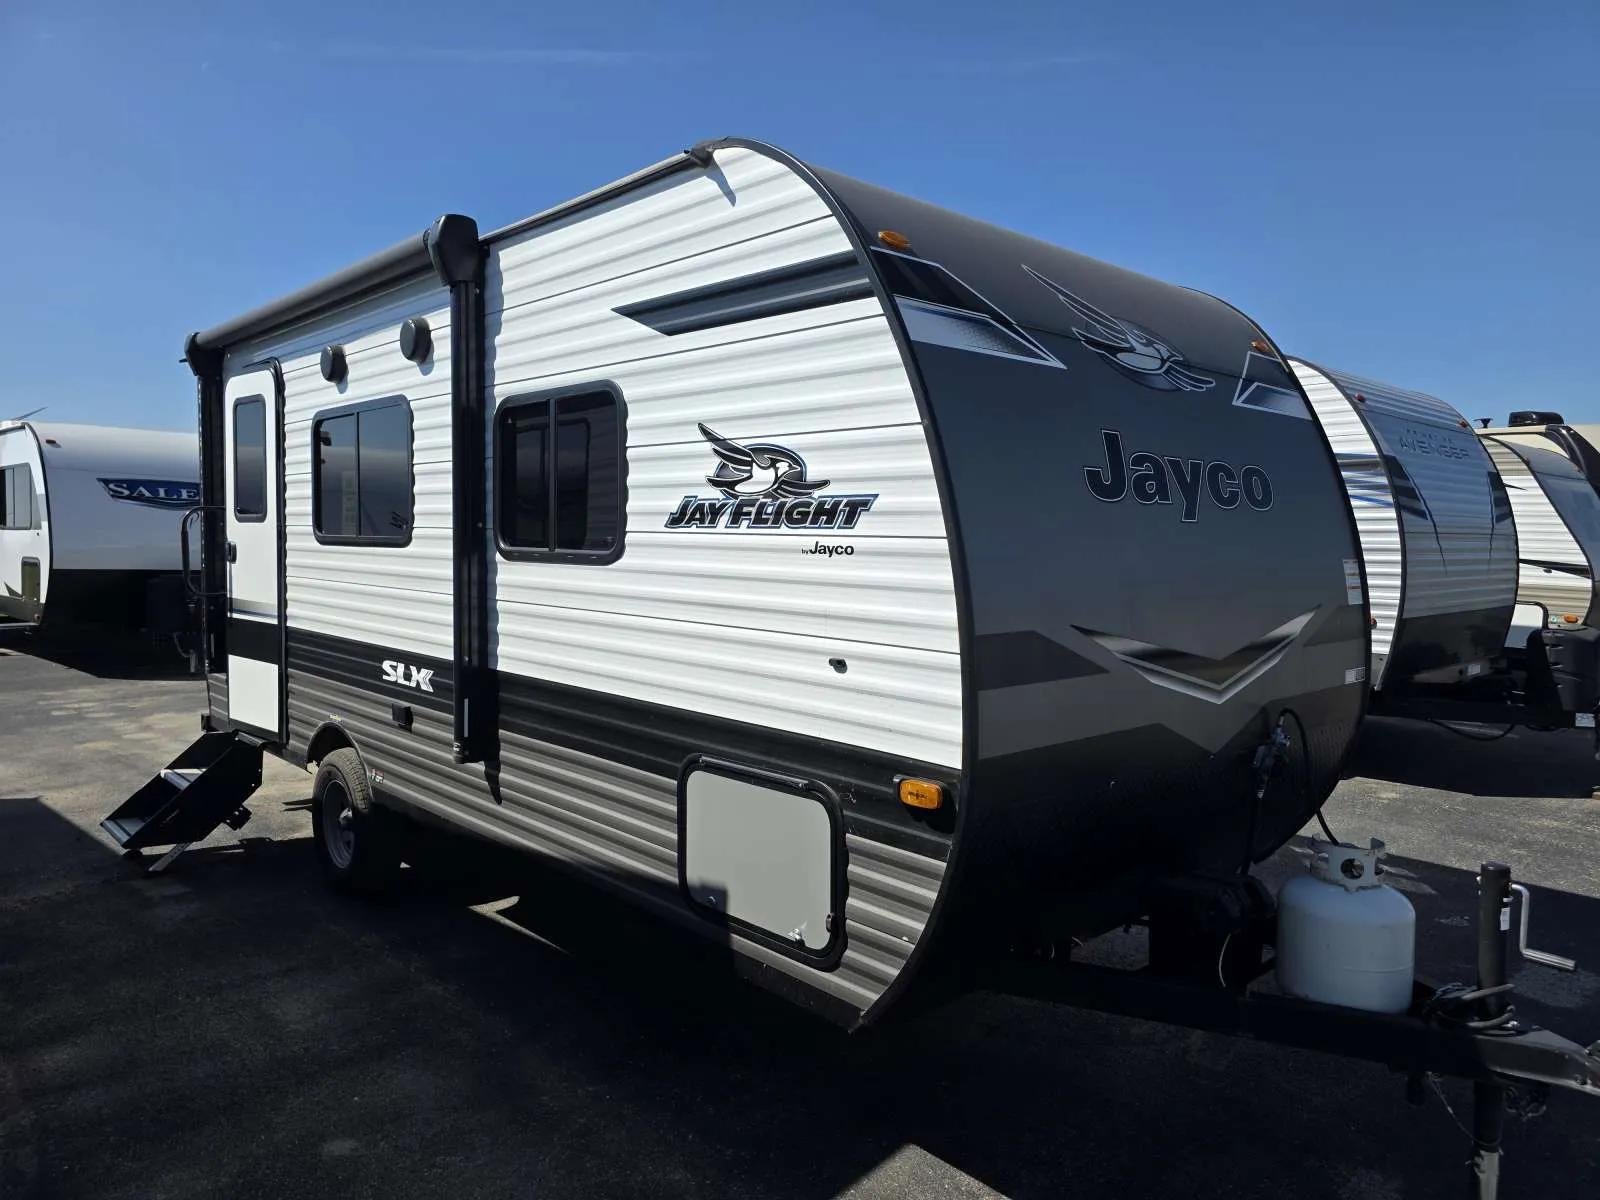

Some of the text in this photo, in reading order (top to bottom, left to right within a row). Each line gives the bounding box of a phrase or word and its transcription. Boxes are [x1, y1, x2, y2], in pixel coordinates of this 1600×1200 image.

[1083, 429, 1274, 523] Jayco
[108, 482, 200, 500] SALE
[664, 493, 880, 529] JAY FLIGHT
[809, 540, 855, 558] Jayco
